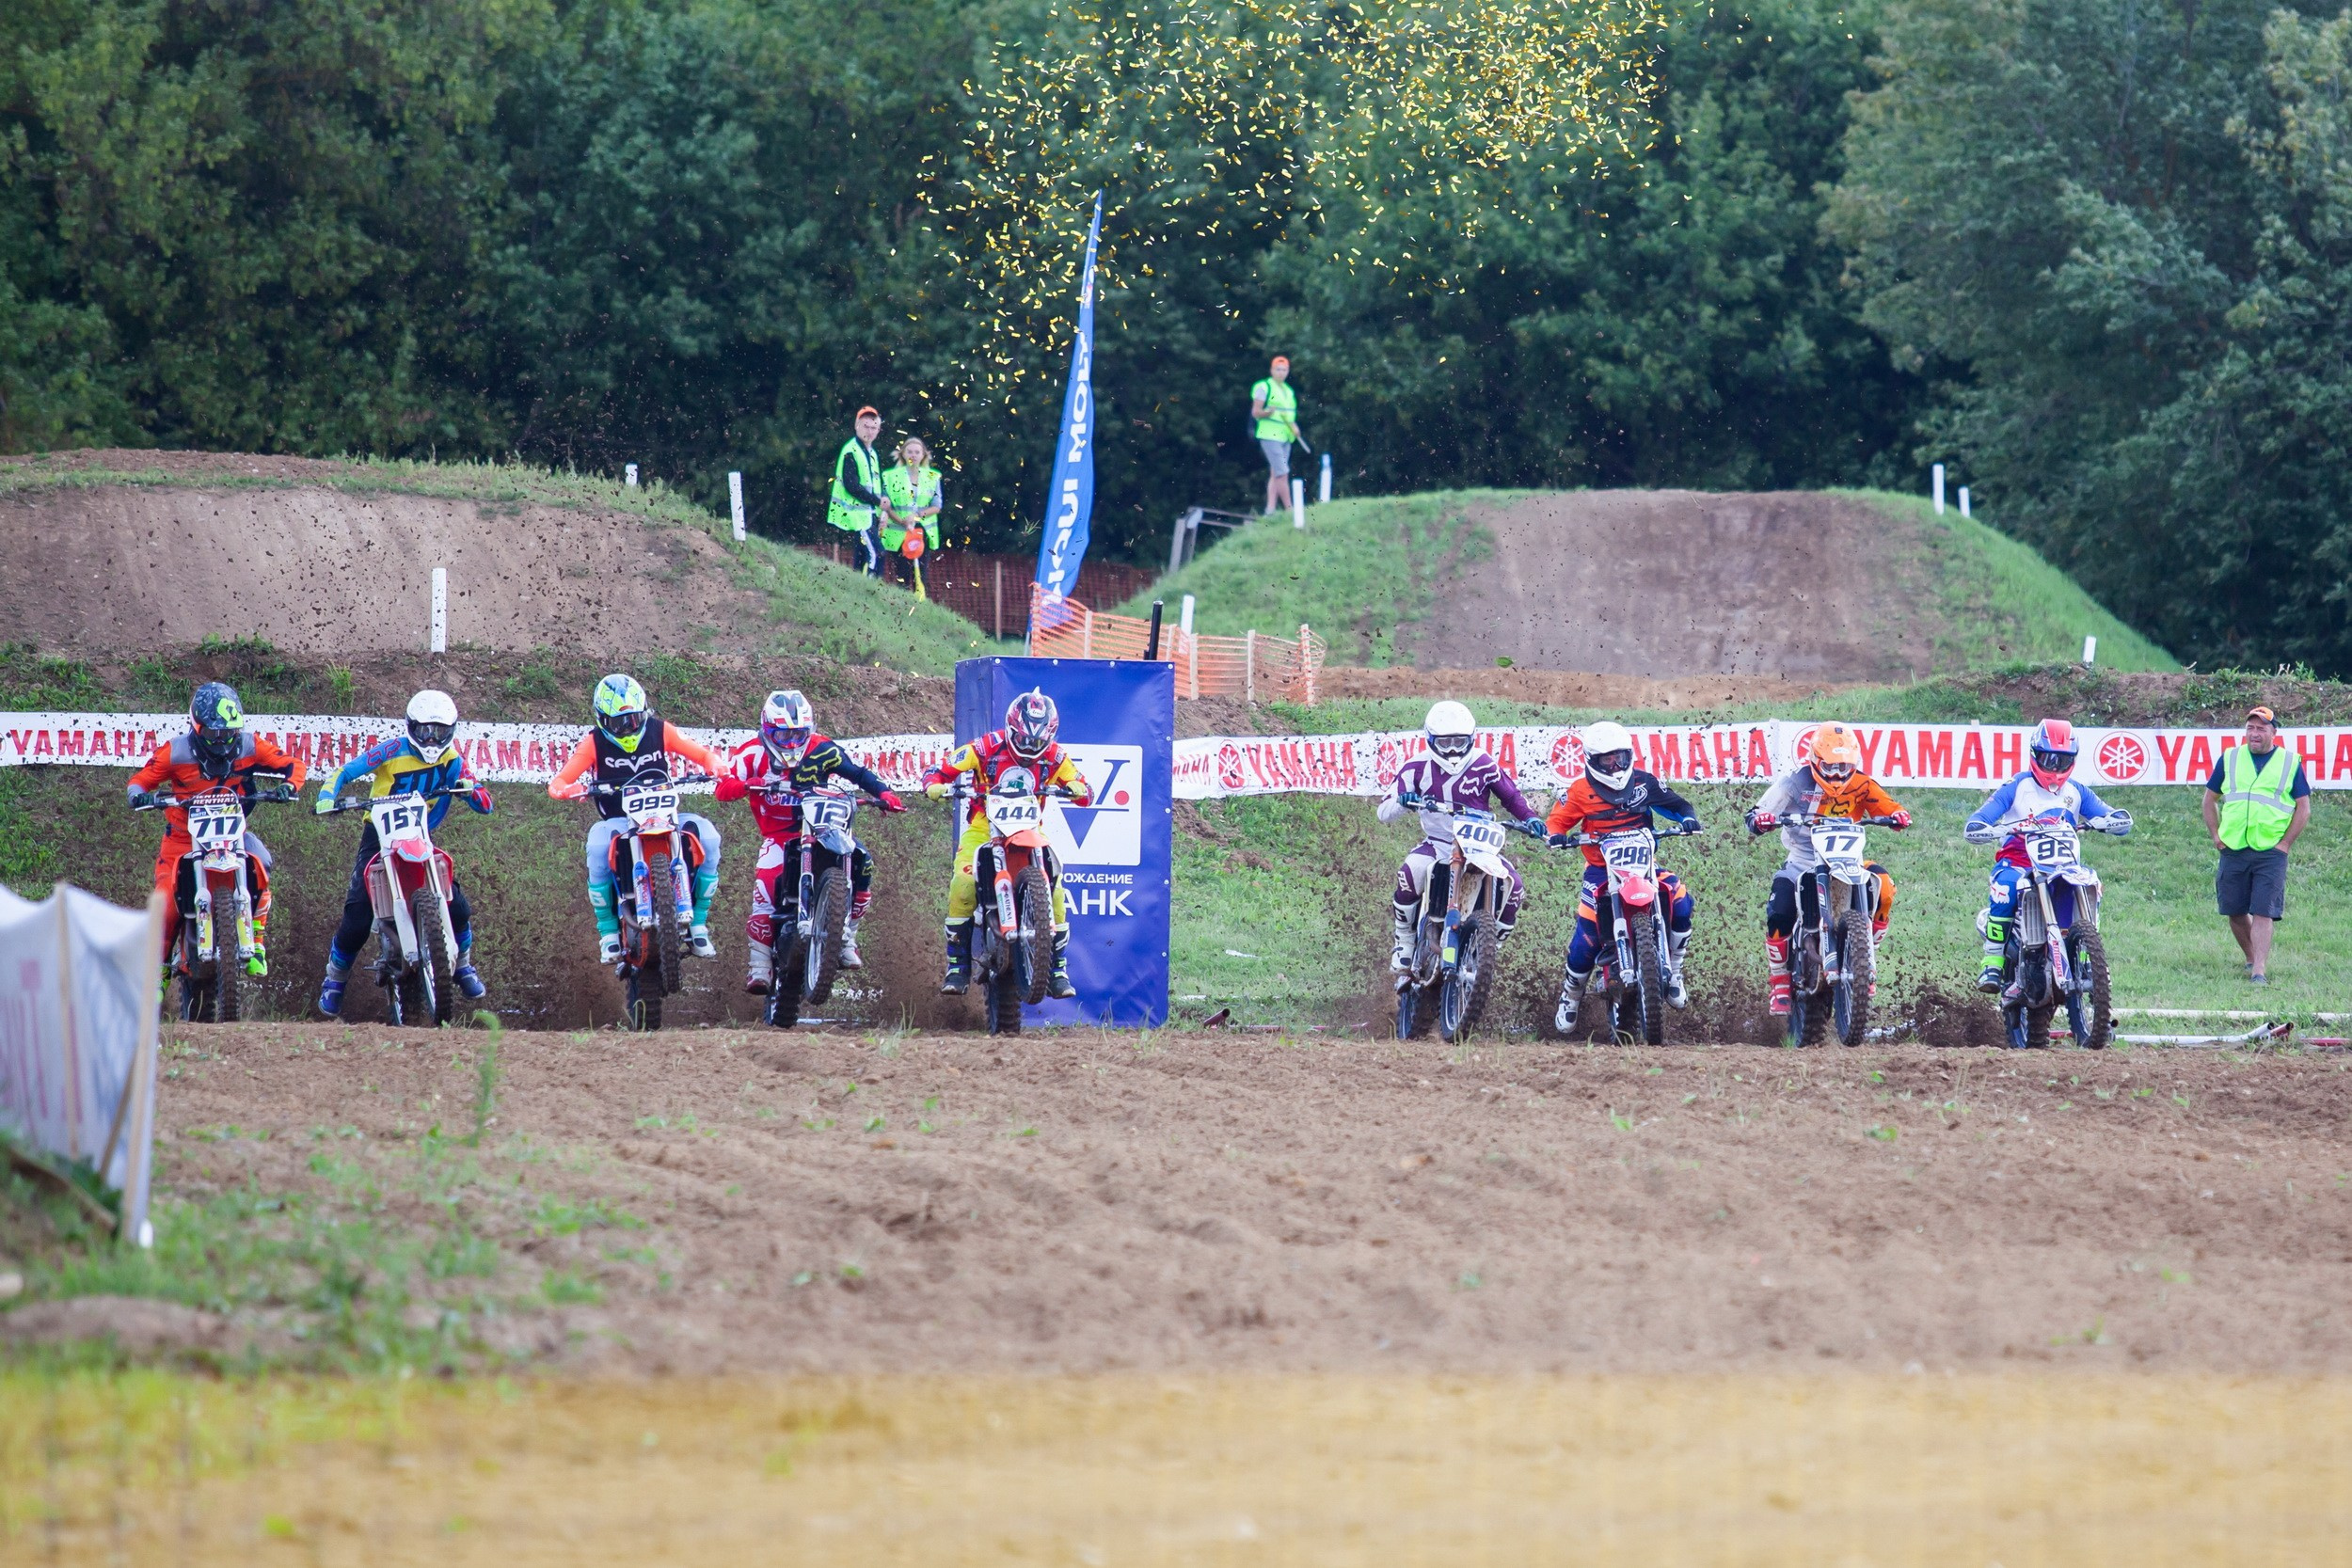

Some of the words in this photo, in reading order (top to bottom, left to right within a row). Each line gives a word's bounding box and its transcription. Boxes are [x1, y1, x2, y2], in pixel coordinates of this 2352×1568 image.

[1068, 333, 1089, 462] MOLY
[9, 729, 158, 756] YAMAHA
[453, 738, 596, 773] YAMAH
[1629, 730, 1772, 779] AMAHA
[1853, 729, 2022, 779] YAMAH
[1246, 741, 1357, 788] YAMAHA
[2155, 734, 2352, 782] YAHA
[628, 795, 675, 814] 999
[813, 801, 851, 830] 12
[994, 806, 1038, 821] 444
[194, 816, 242, 838] 717
[381, 806, 423, 835] 157
[1456, 824, 1503, 847] 400
[1824, 835, 1859, 852] 17
[1610, 847, 1650, 866] 298
[2038, 840, 2074, 861] 92
[1063, 873, 1134, 884] ОЖДЕНИЕ
[1064, 887, 1134, 916] АНК
